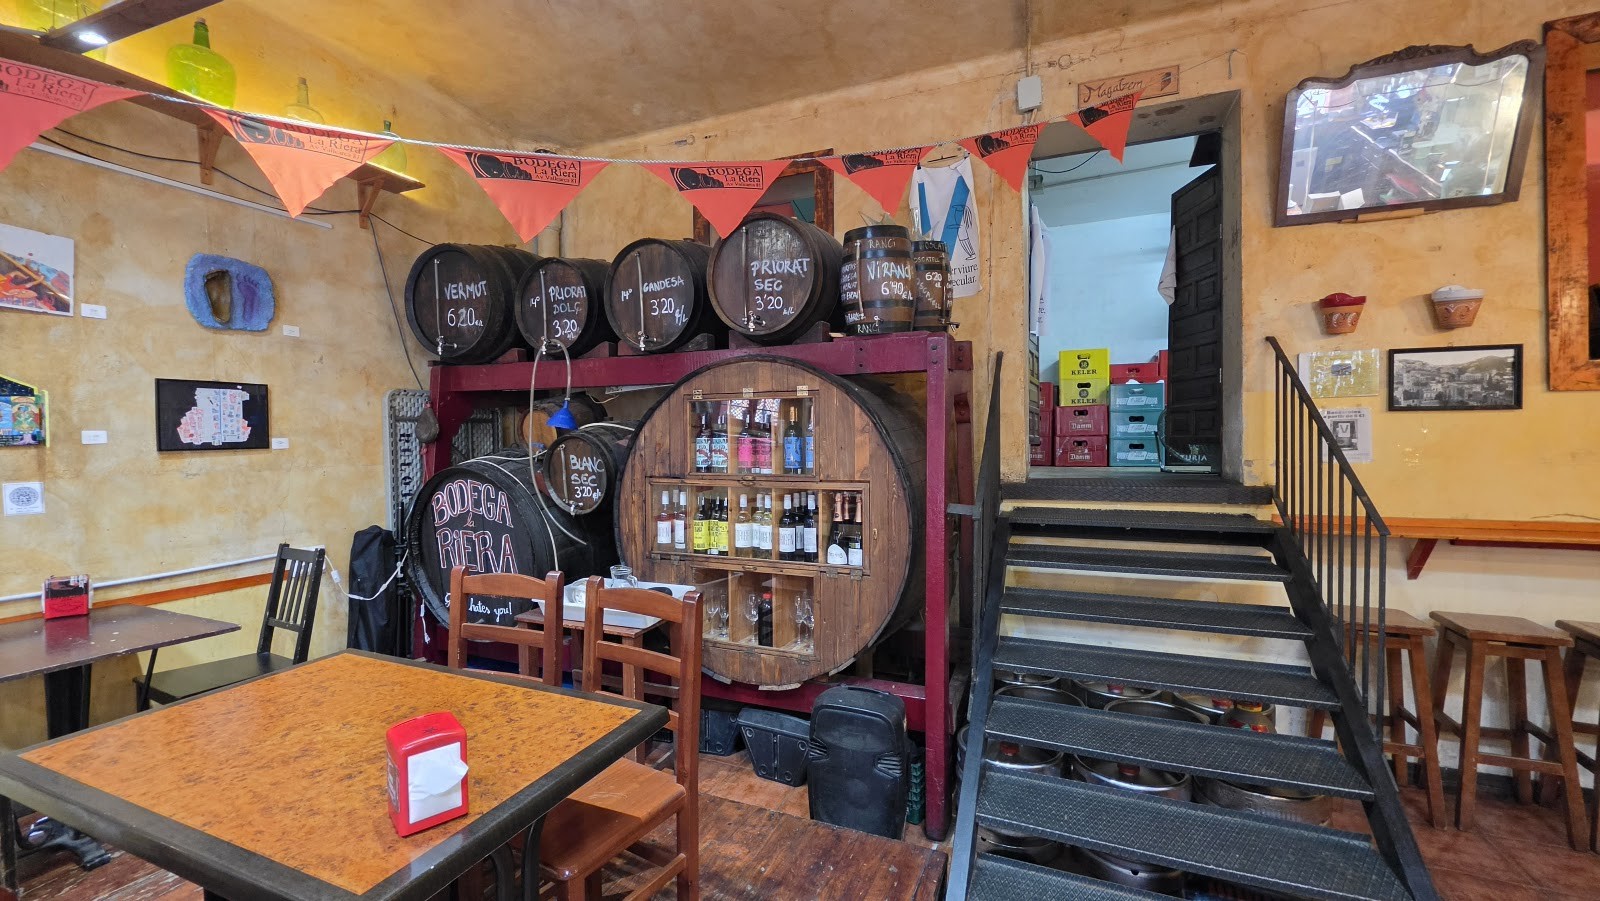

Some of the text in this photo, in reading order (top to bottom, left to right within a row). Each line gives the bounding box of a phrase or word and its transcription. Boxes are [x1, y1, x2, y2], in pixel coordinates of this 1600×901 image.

[0, 63, 87, 95] ODEGA
[1083, 77, 1143, 103] Magatzem
[308, 135, 361, 154] La Riera
[513, 157, 577, 170] BODEGA
[534, 166, 577, 179] La Riera
[707, 167, 760, 176] BODEGA
[739, 175, 761, 183] Riera
[751, 258, 811, 278] PRIORAT
[444, 280, 487, 300] VERMUT
[643, 275, 685, 293] GANDESA
[754, 278, 783, 291] SEC
[549, 285, 587, 303] PRIORAT
[755, 294, 783, 311] 3'20
[1071, 422, 1092, 430] Damm
[569, 454, 605, 473] BLANC
[1070, 453, 1091, 461] Damm
[570, 472, 598, 487] SEC
[432, 479, 514, 528] BODEGA
[468, 597, 491, 614] hates
[493, 602, 513, 622] you!
